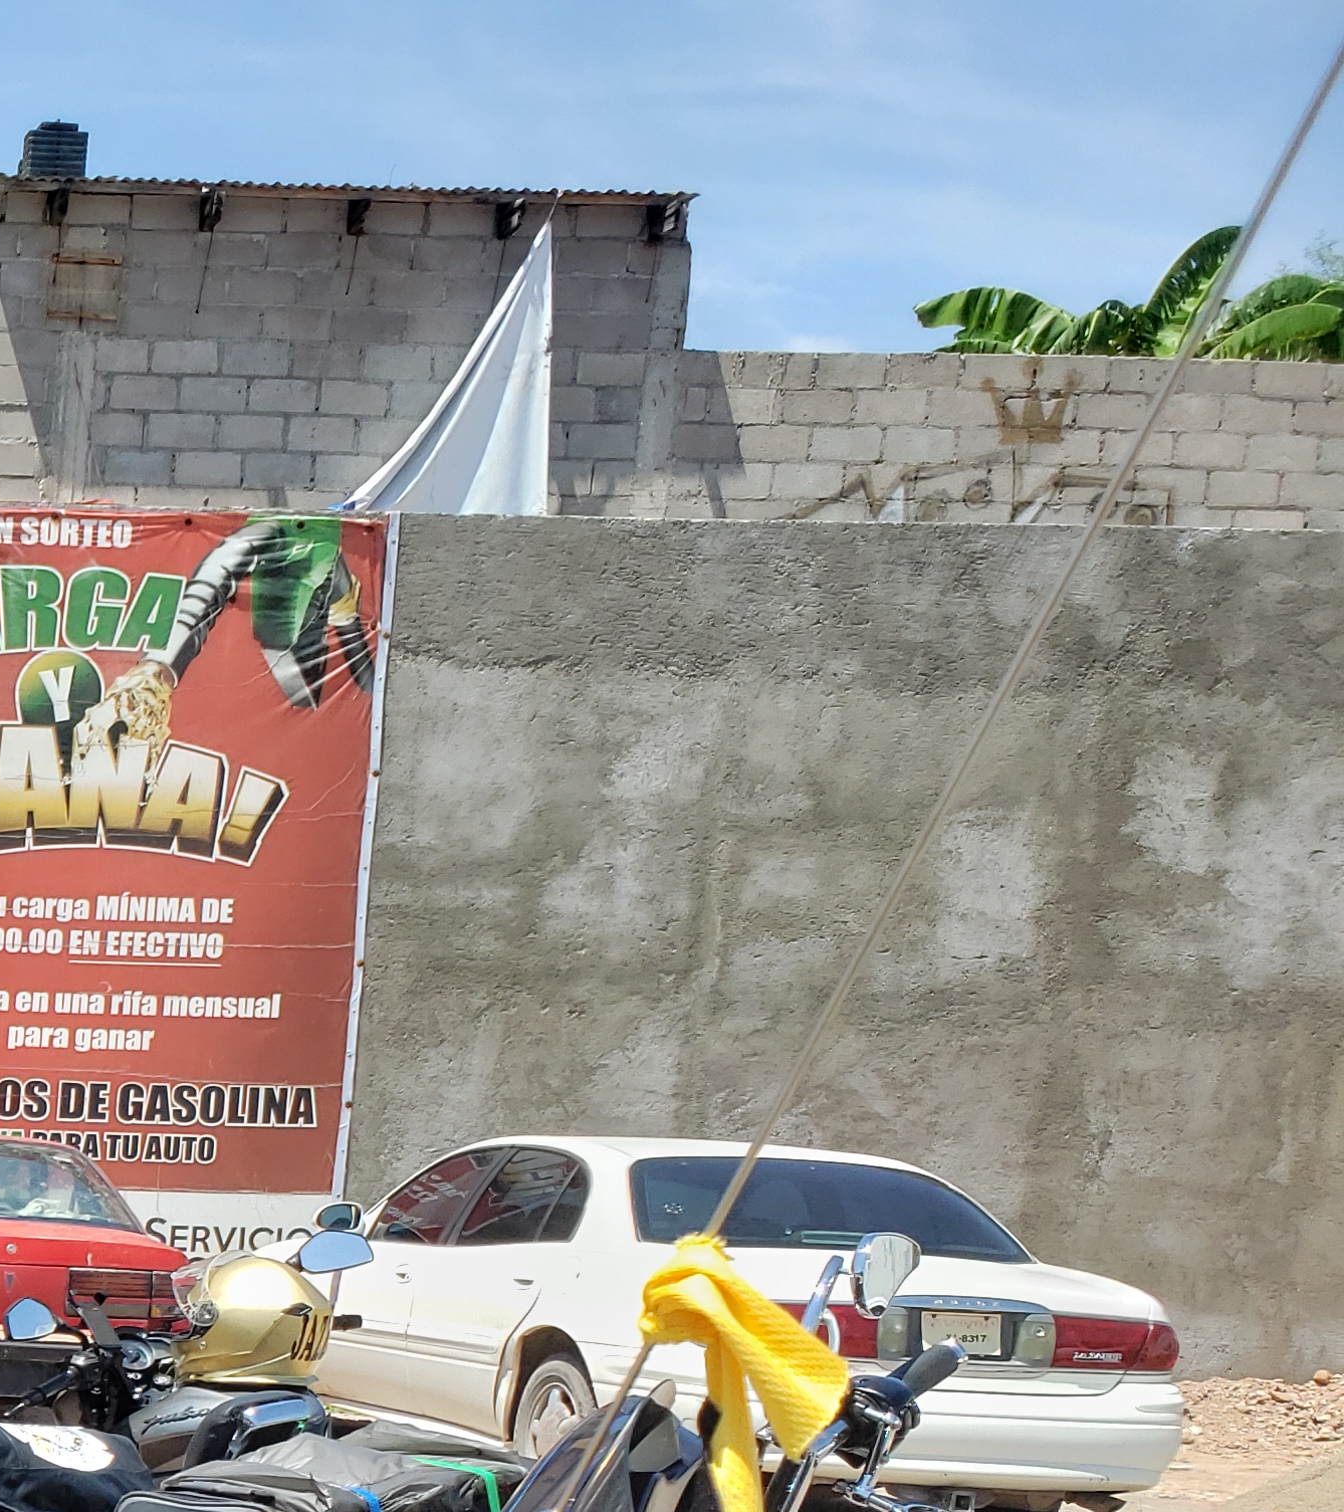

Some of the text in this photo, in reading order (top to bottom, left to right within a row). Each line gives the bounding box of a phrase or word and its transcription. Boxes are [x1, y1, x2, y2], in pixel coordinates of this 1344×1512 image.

[19, 517, 132, 549] SORTEO
[38, 665, 75, 722] Y
[12, 896, 89, 924] carga
[95, 892, 196, 923] MÍNIMA
[200, 897, 234, 924] DE
[68, 928, 100, 957] EN
[105, 930, 224, 959] EFECTIVO
[15, 989, 49, 1012] en
[54, 992, 107, 1015] una
[110, 990, 158, 1017] rifa
[162, 993, 280, 1019] mensual
[7, 1024, 154, 1053] para ganar
[56, 1080, 110, 1123] DE
[117, 1082, 317, 1128] GASOLINA
[103, 1132, 138, 1162] TU
[143, 1133, 217, 1164] AUTO
